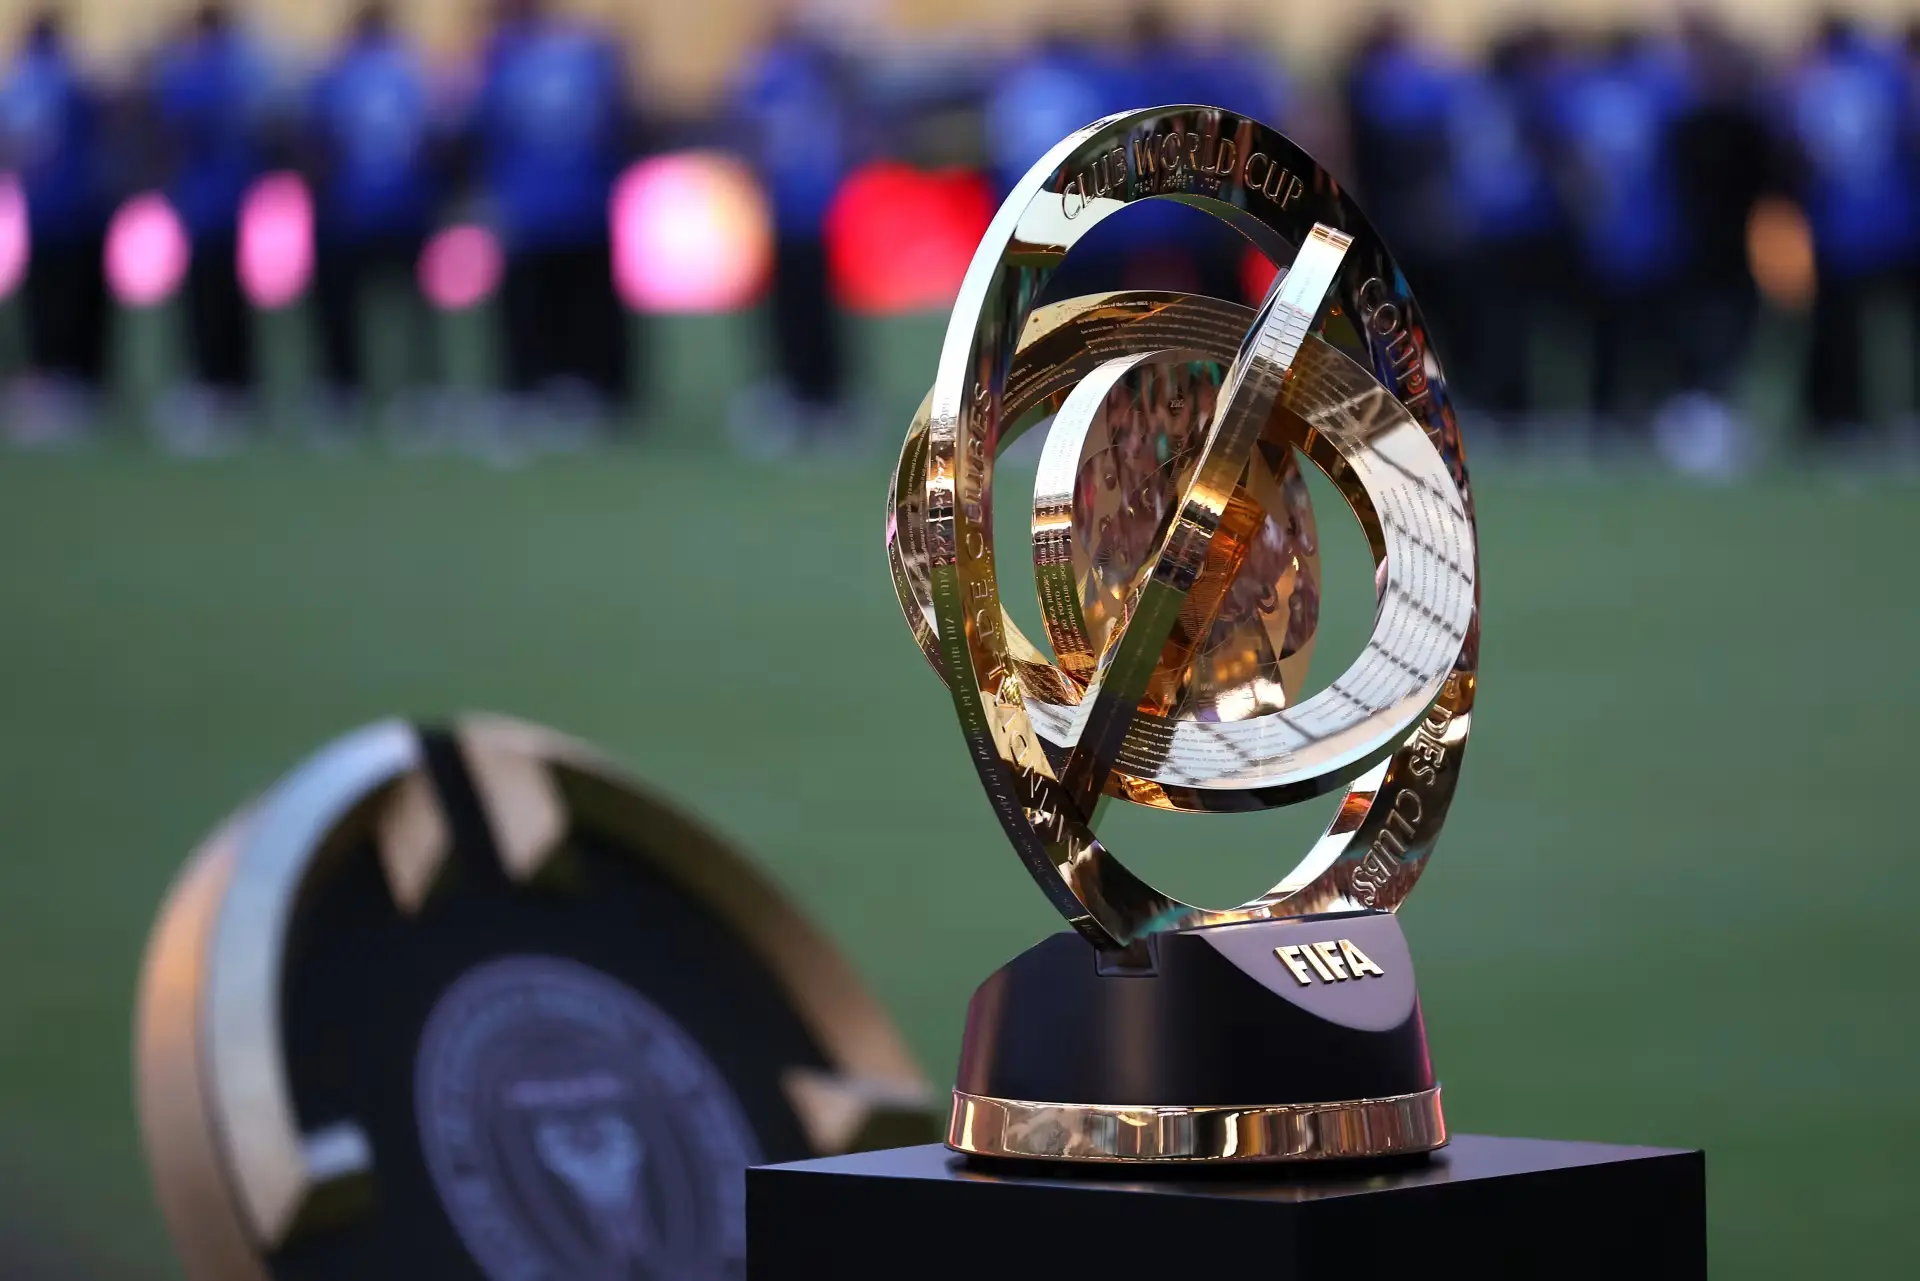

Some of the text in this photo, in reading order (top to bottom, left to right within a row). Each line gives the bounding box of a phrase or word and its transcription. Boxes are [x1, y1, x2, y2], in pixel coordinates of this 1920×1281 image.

[1061, 132, 1304, 220] CLUB WORLD CUP
[965, 382, 992, 560] CLUBES
[970, 579, 993, 642] DE
[1054, 590, 1065, 615] PORTO
[1409, 704, 1453, 787] DES
[1352, 788, 1423, 906] CLUBS
[1273, 939, 1385, 986] FIFA
